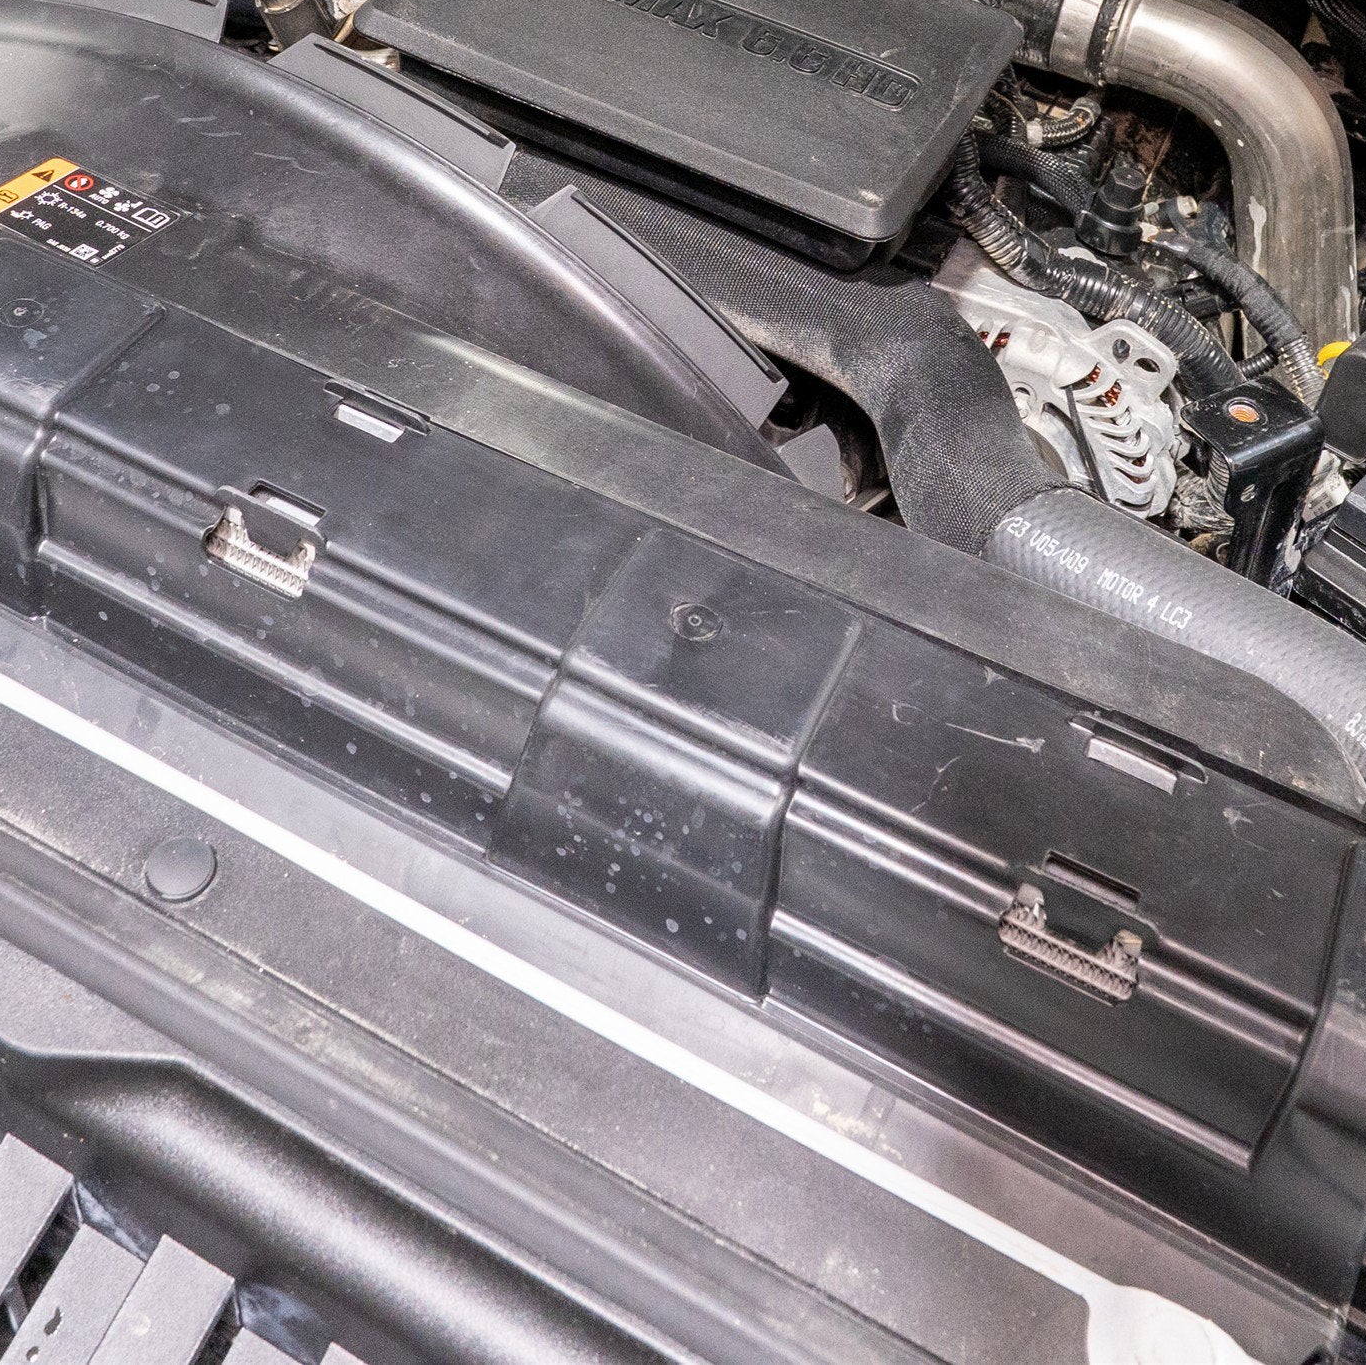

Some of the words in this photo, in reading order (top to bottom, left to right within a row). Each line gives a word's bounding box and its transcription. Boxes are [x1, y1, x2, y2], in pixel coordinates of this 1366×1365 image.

[740, 30, 831, 74] 6.6
[831, 56, 915, 108] HD
[31, 218, 53, 230] PAG
[58, 200, 87, 219] R-134a
[95, 219, 120, 235] 0.700
[1096, 568, 1144, 605] MOTOR
[1147, 595, 1160, 613] 4
[1160, 601, 1193, 629] LC3
